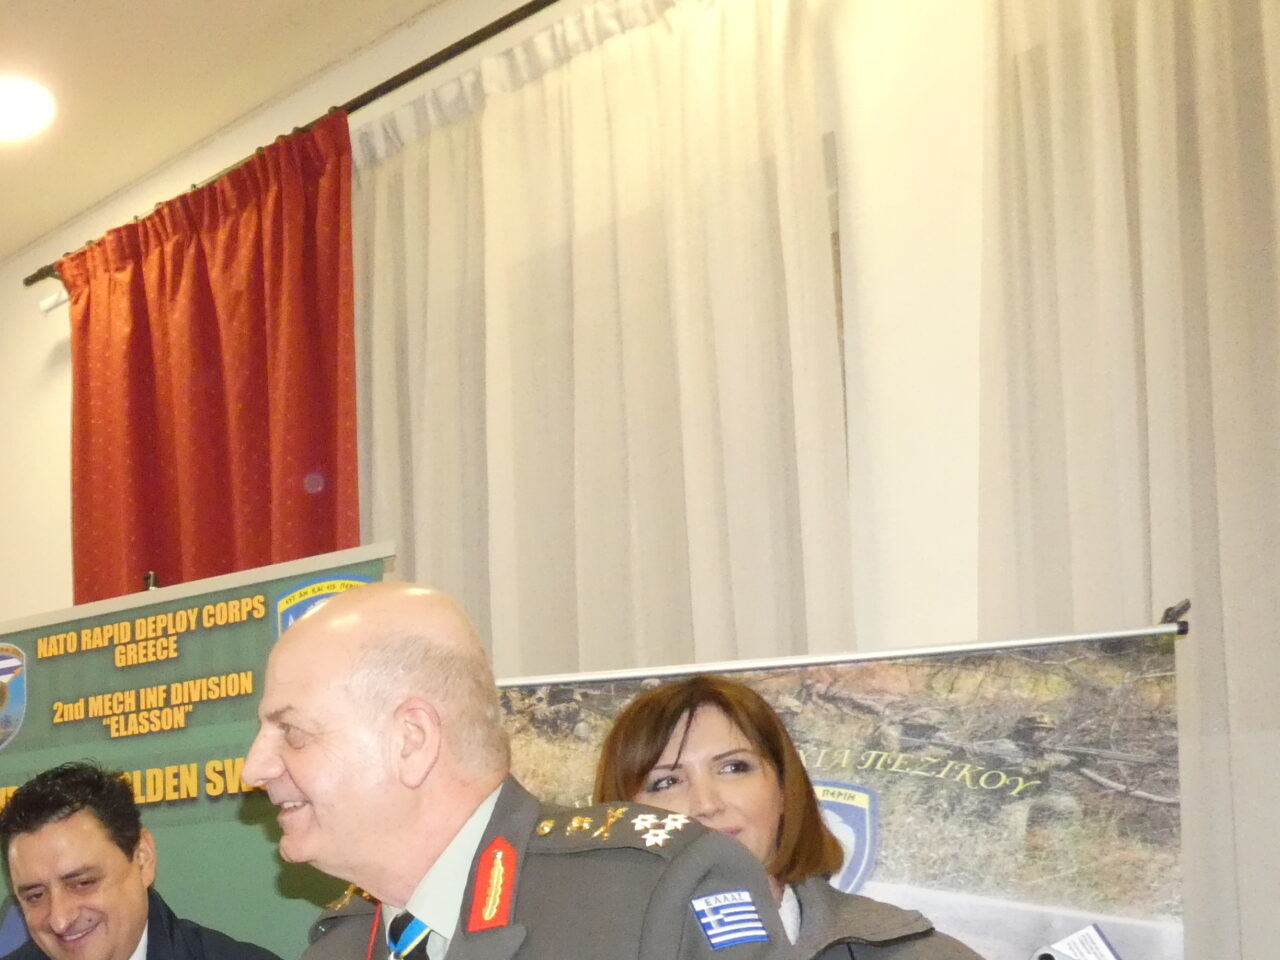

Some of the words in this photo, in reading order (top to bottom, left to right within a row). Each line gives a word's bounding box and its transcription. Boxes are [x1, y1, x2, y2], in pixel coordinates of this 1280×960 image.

[37, 631, 78, 659] NATO
[81, 621, 131, 650] RAPID
[135, 607, 199, 640] DEPLOY
[202, 594, 266, 628] CORPS
[114, 635, 178, 668] GREECE
[53, 698, 85, 724] 2nd
[88, 690, 136, 718] MECH
[140, 685, 167, 709] INF
[170, 671, 253, 706] DIVISION
[103, 704, 194, 738] “ELASSON”
[116, 763, 198, 804] LDEN
[205, 757, 269, 797] SW
[857, 750, 1042, 798] ΠΕΖΙΚΟΥ
